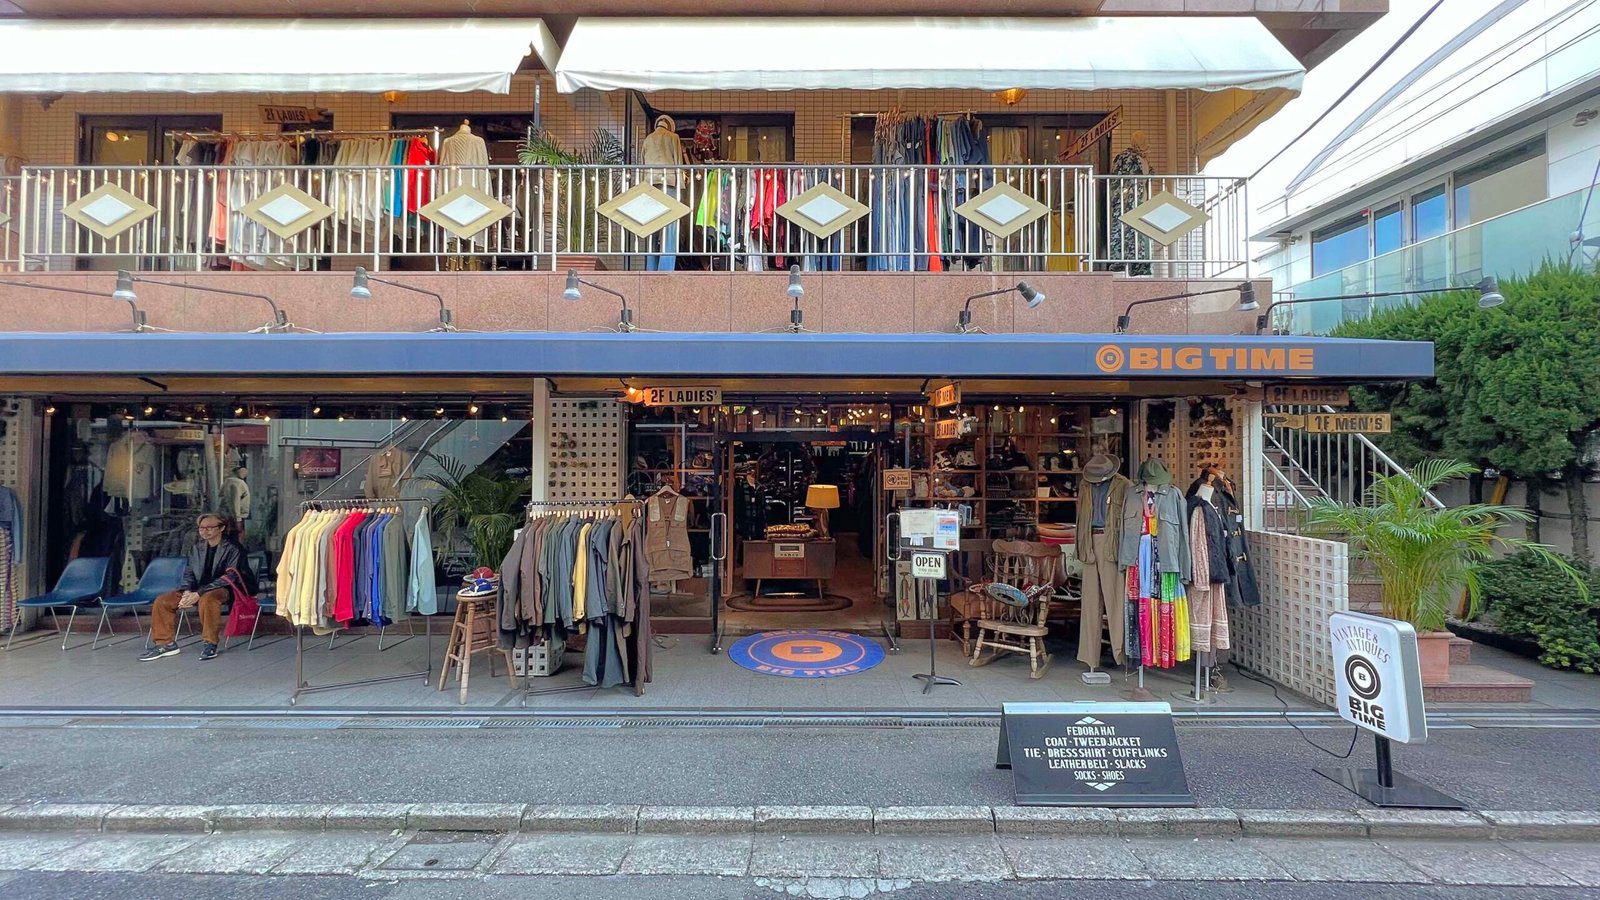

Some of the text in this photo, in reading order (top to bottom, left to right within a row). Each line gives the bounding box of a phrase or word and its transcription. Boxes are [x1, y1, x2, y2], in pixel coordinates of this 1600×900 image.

[1129, 347, 1314, 370] BIG TIME
[651, 389, 718, 403] 2F LADIES'
[1273, 387, 1345, 401] 2F LADIES'
[1314, 415, 1383, 431] 1F MEN'S
[915, 556, 941, 568] OPEN
[1333, 625, 1371, 641] VINTAGE
[1346, 639, 1391, 664] ANTIQUES
[756, 665, 860, 676] BIG TIME
[1358, 672, 1366, 681] B
[1348, 695, 1385, 720] BIG
[1350, 709, 1386, 731] TIME
[1066, 726, 1116, 736] FEDORA HAT
[1045, 737, 1141, 747] COAT TWEED JACKET
[1024, 748, 1168, 758] TIE DRESS SHIRT CUFFLINKS
[1048, 759, 1147, 769] LEATHER BELT SLACKS
[1074, 770, 1125, 780] SOCKS SHOES
